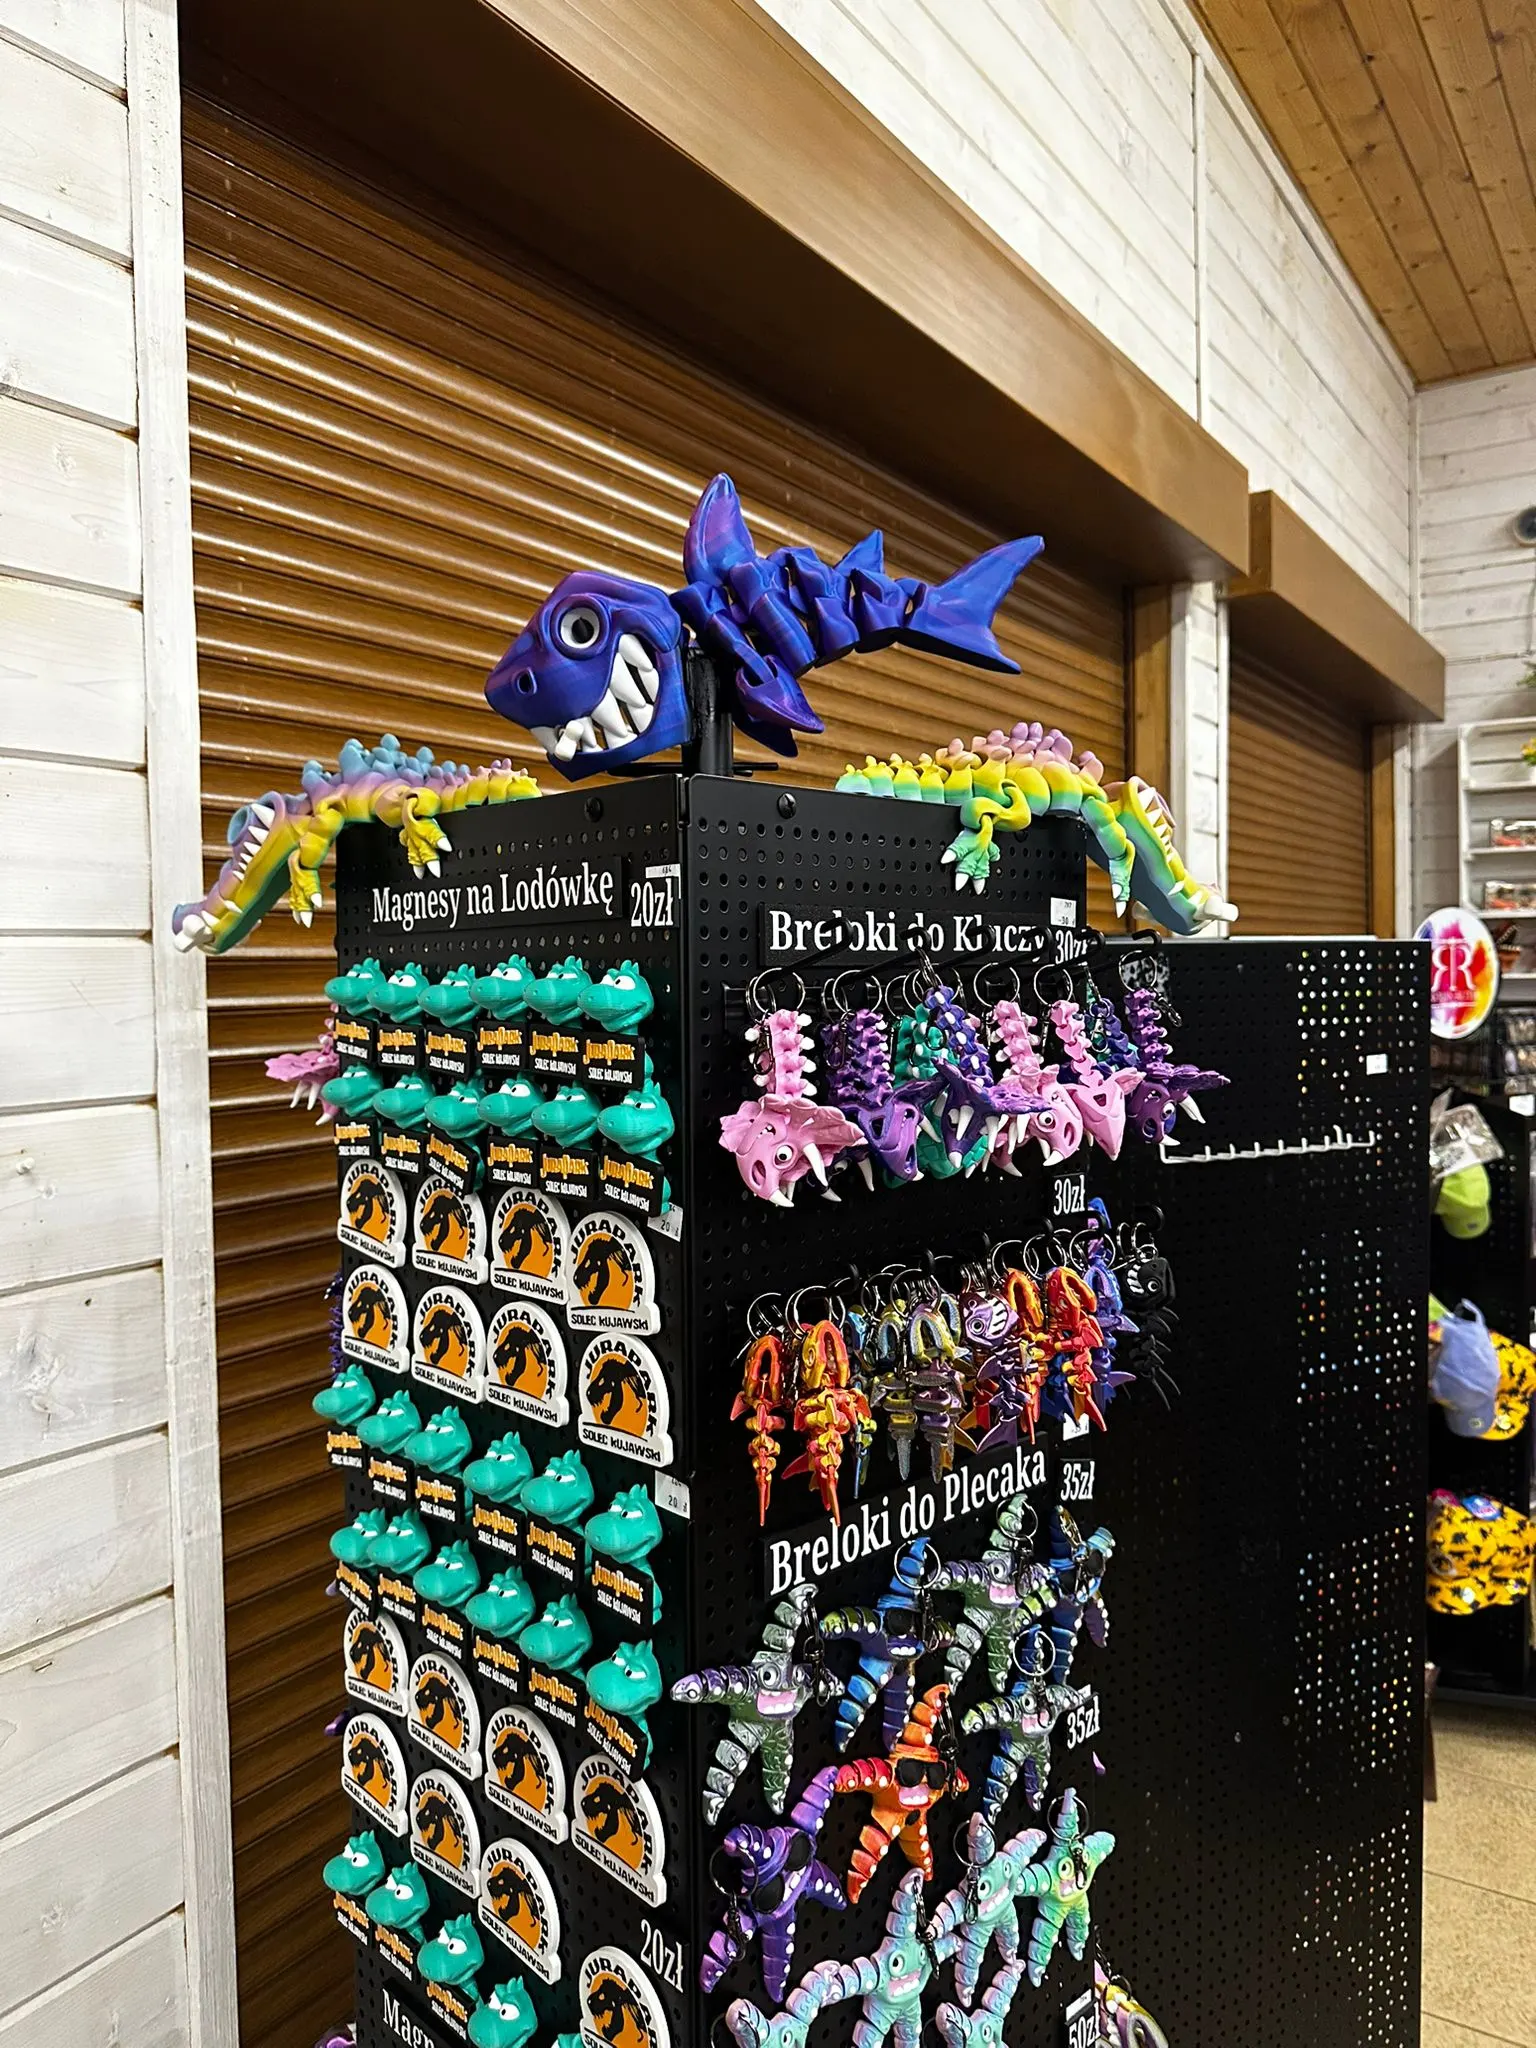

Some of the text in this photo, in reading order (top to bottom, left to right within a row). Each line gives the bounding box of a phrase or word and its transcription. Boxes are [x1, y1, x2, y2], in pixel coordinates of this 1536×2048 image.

[372, 862, 613, 931] Magnesy na Lodówkę
[631, 878, 673, 927] 20zł
[1054, 1174, 1085, 1215] 30zł
[668, 1494, 677, 1508] 20
[1060, 1461, 1095, 1500] 35zł
[770, 1445, 1046, 1596] Breloki do Plecaka
[1067, 1695, 1100, 1749] 35zł
[640, 1919, 684, 1993] 20zł
